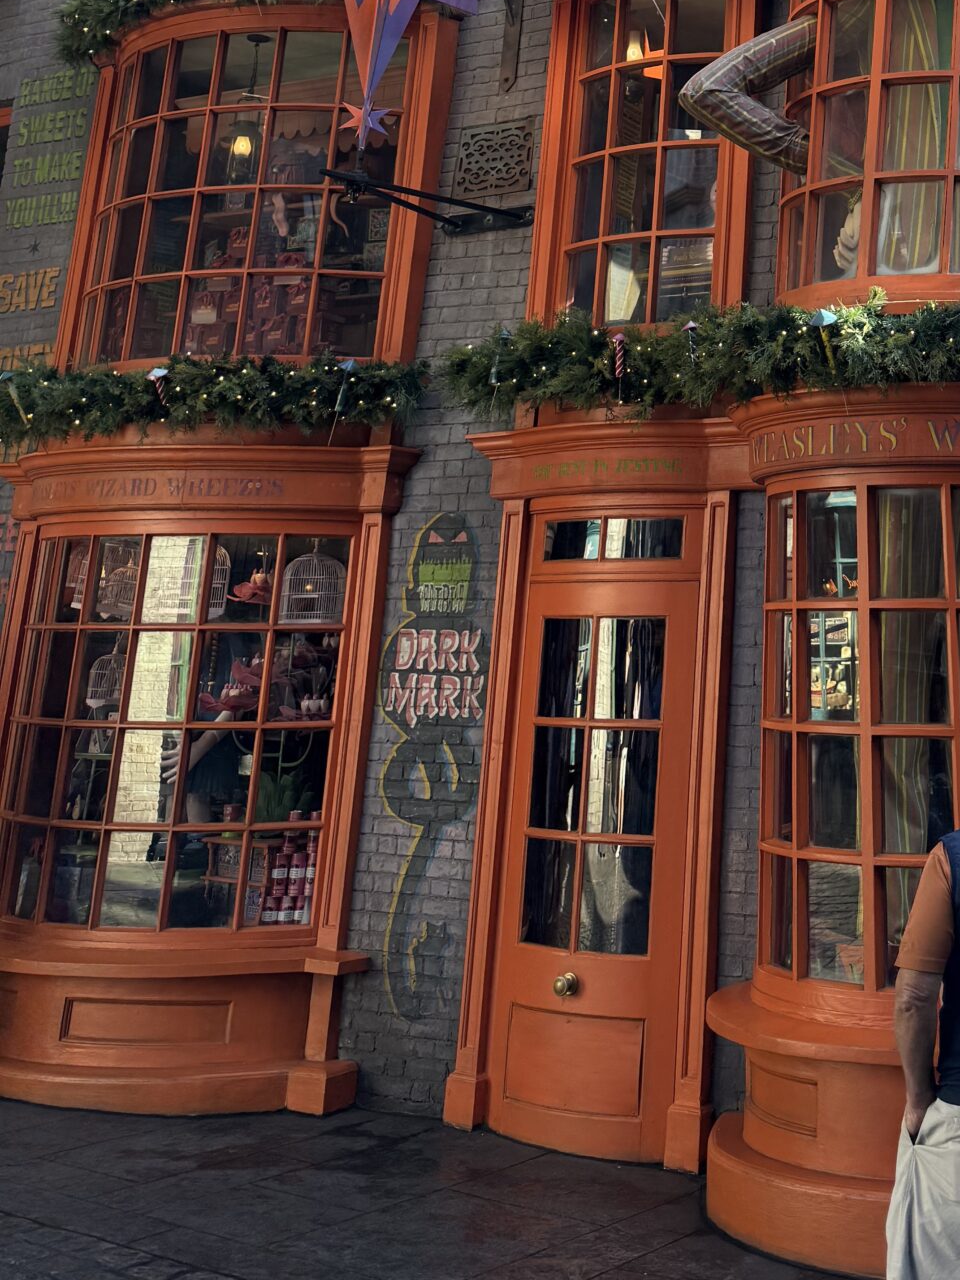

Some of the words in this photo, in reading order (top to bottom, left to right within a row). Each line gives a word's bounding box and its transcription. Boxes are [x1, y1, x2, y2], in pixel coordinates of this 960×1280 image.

[19, 71, 74, 108] RANGE
[17, 107, 88, 148] SWEETS
[13, 159, 34, 188] TO
[34, 151, 82, 186] MAKE
[0, 267, 61, 314] SAVE
[395, 628, 482, 674] DARK
[385, 672, 484, 728] MARK
